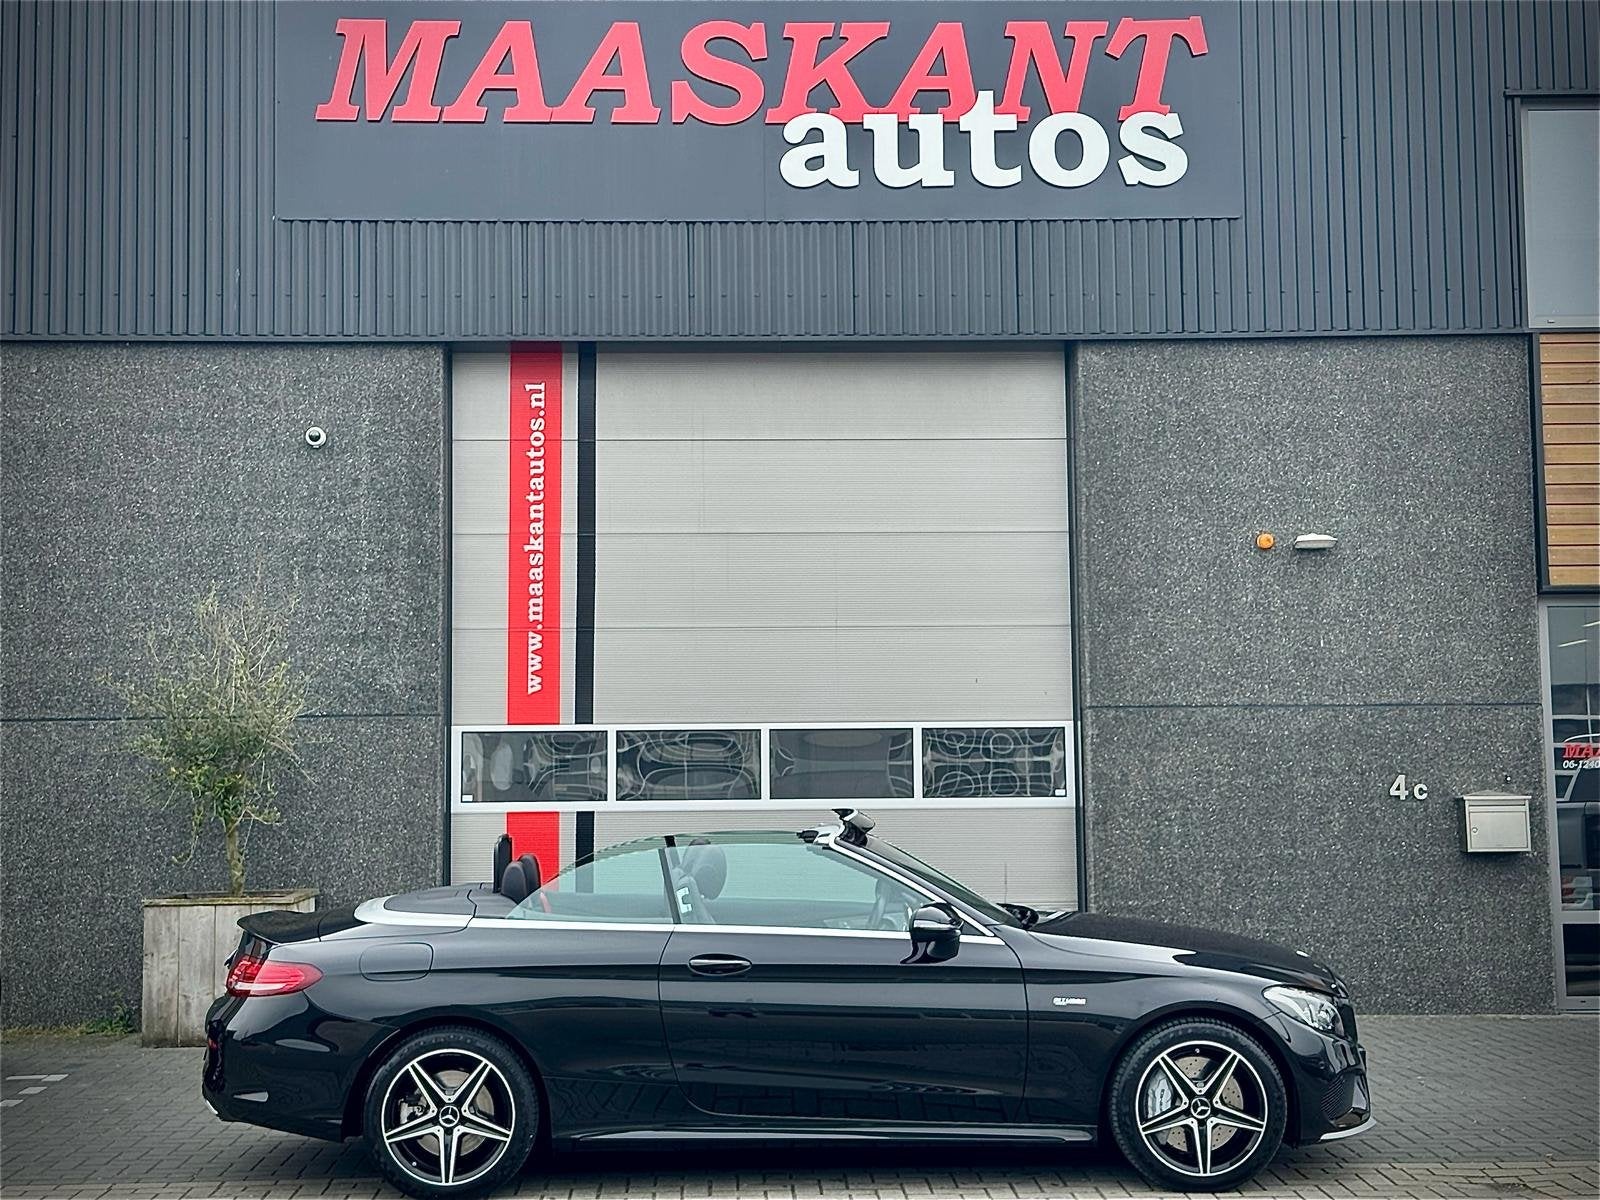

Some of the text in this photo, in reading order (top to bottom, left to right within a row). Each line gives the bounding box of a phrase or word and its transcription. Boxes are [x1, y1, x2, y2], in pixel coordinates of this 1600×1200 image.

[316, 16, 1209, 125] MAASKANT
[779, 89, 1189, 189] autos
[523, 381, 546, 695] www.maaskantautos.nl
